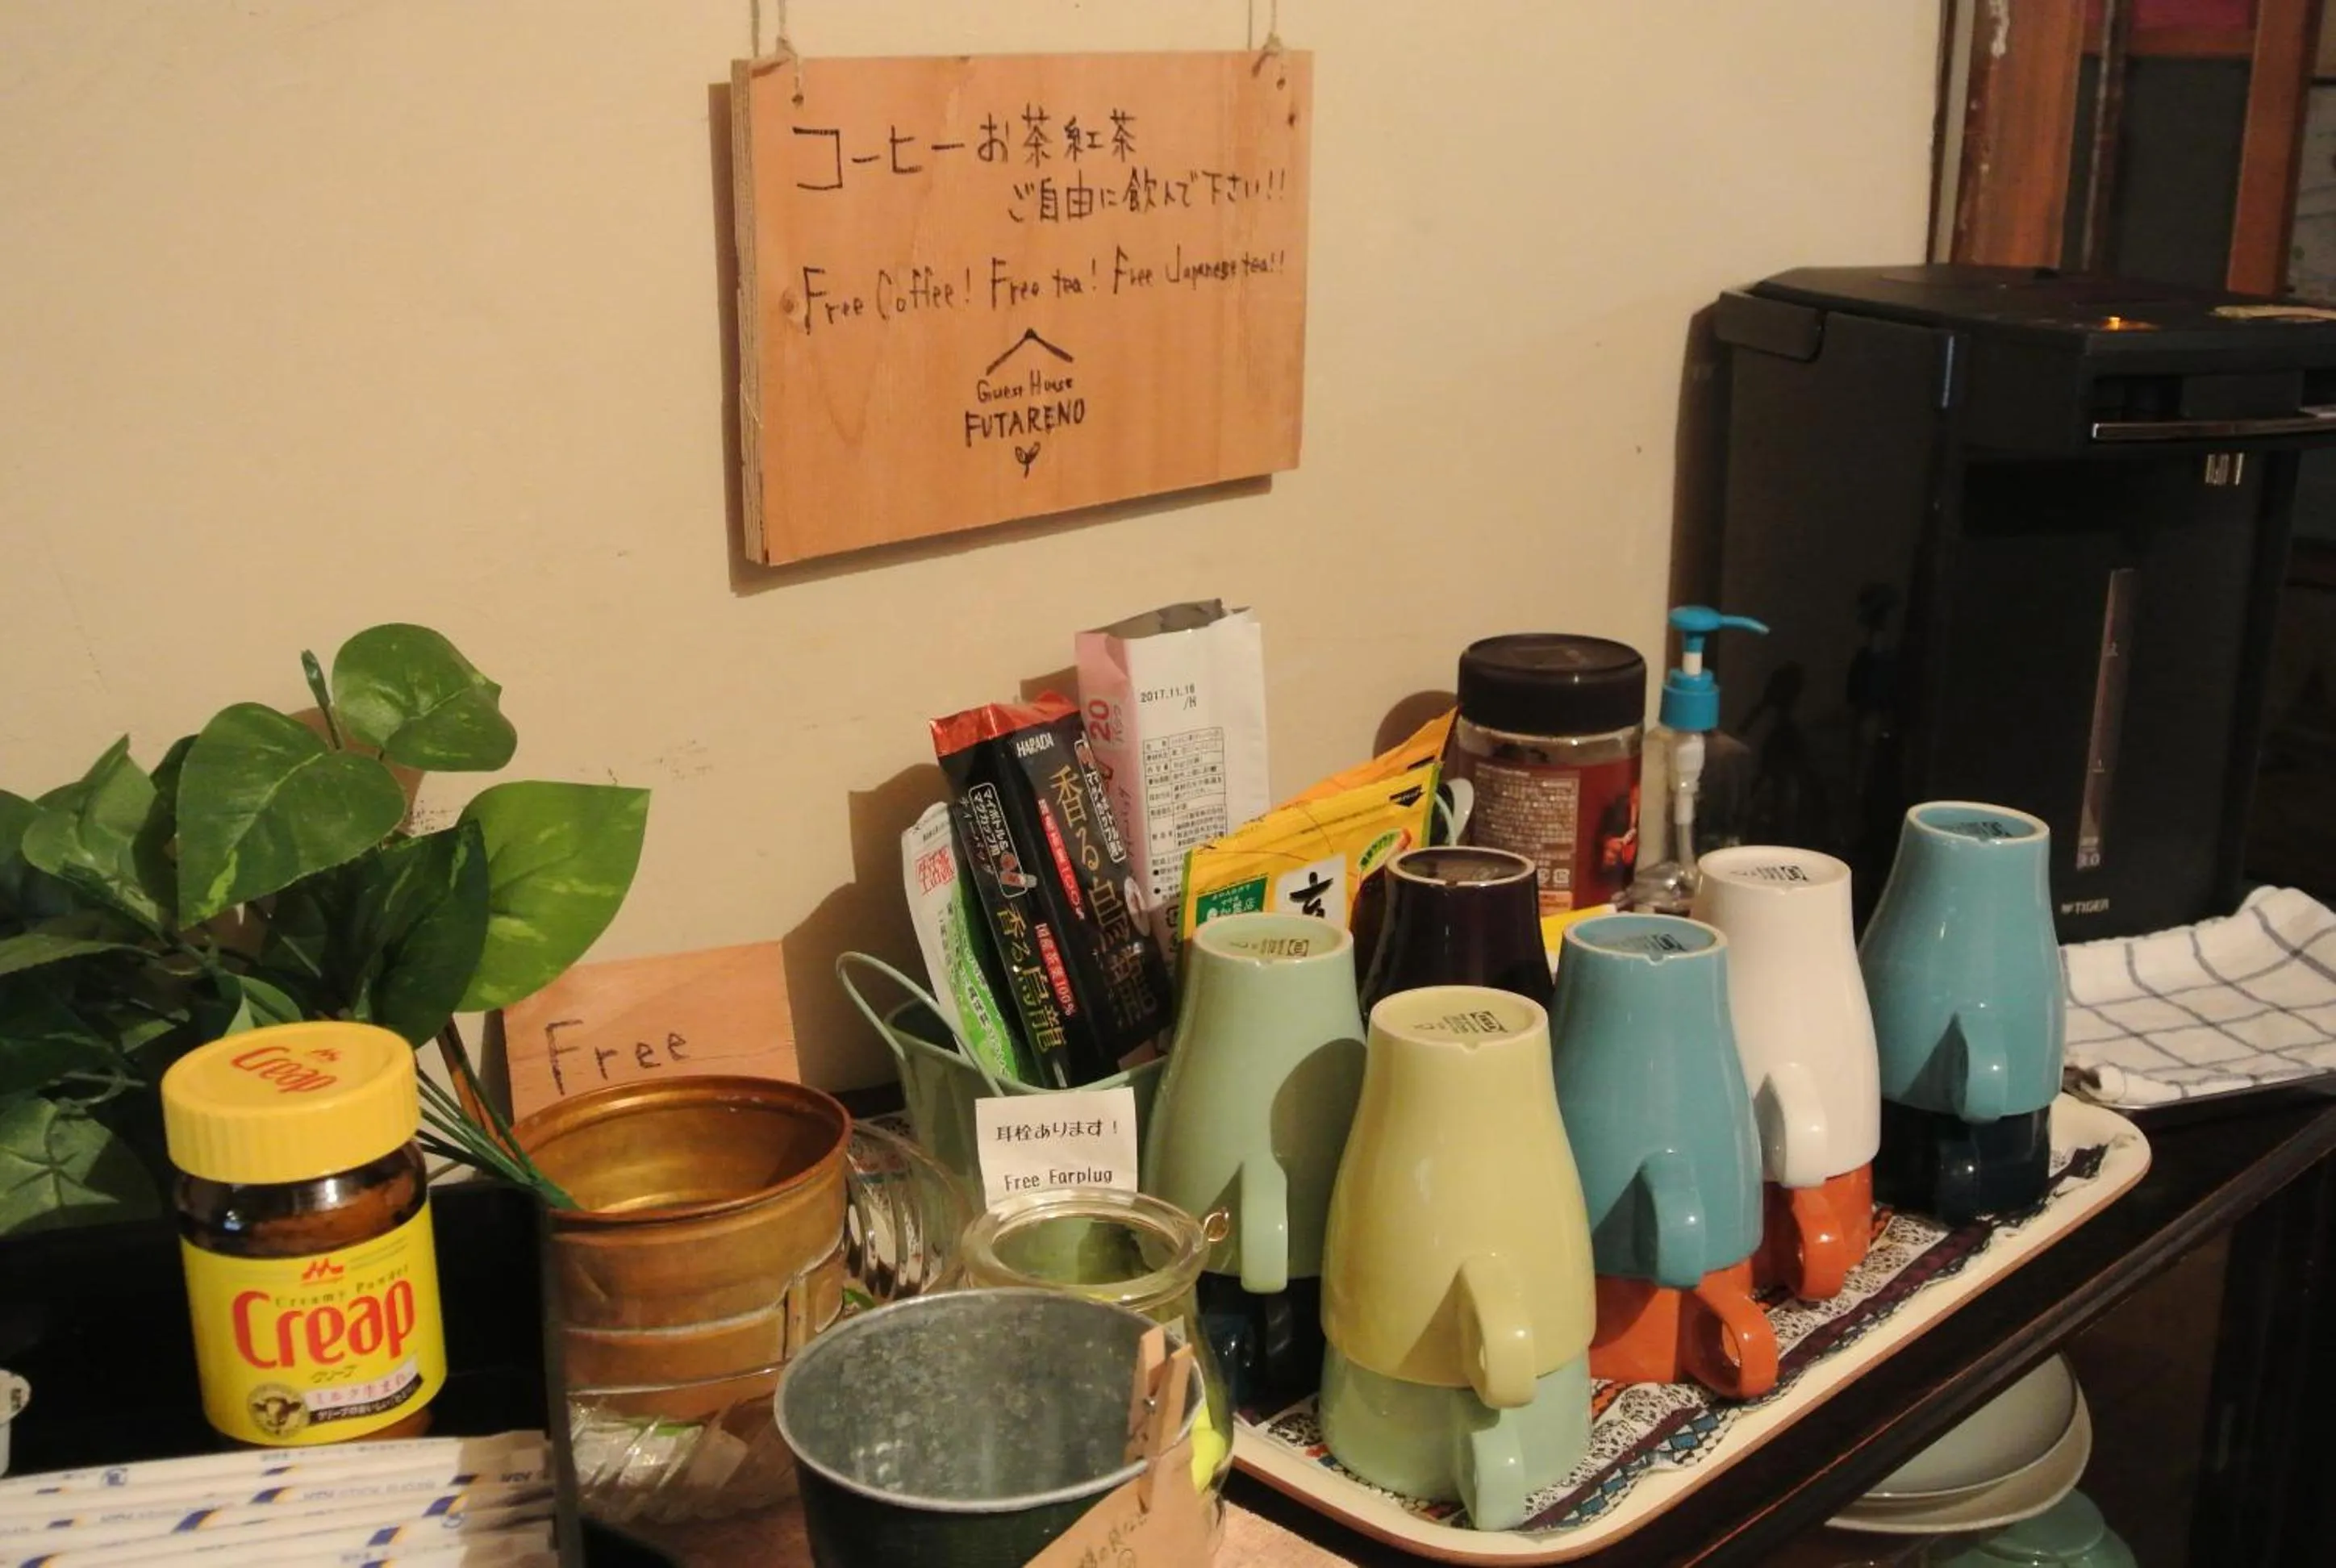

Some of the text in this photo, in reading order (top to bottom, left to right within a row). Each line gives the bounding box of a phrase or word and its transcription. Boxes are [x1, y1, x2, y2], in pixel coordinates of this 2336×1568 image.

[803, 266, 863, 335] Free
[991, 256, 1039, 310] Free
[1113, 245, 1153, 295] Free
[965, 399, 1086, 447] FUTARENO
[1016, 732, 1054, 757] HARADA
[231, 1046, 337, 1094] Creap
[544, 1020, 690, 1095] Free
[1004, 1174, 1040, 1191] Free
[232, 1279, 415, 1370] Creap
